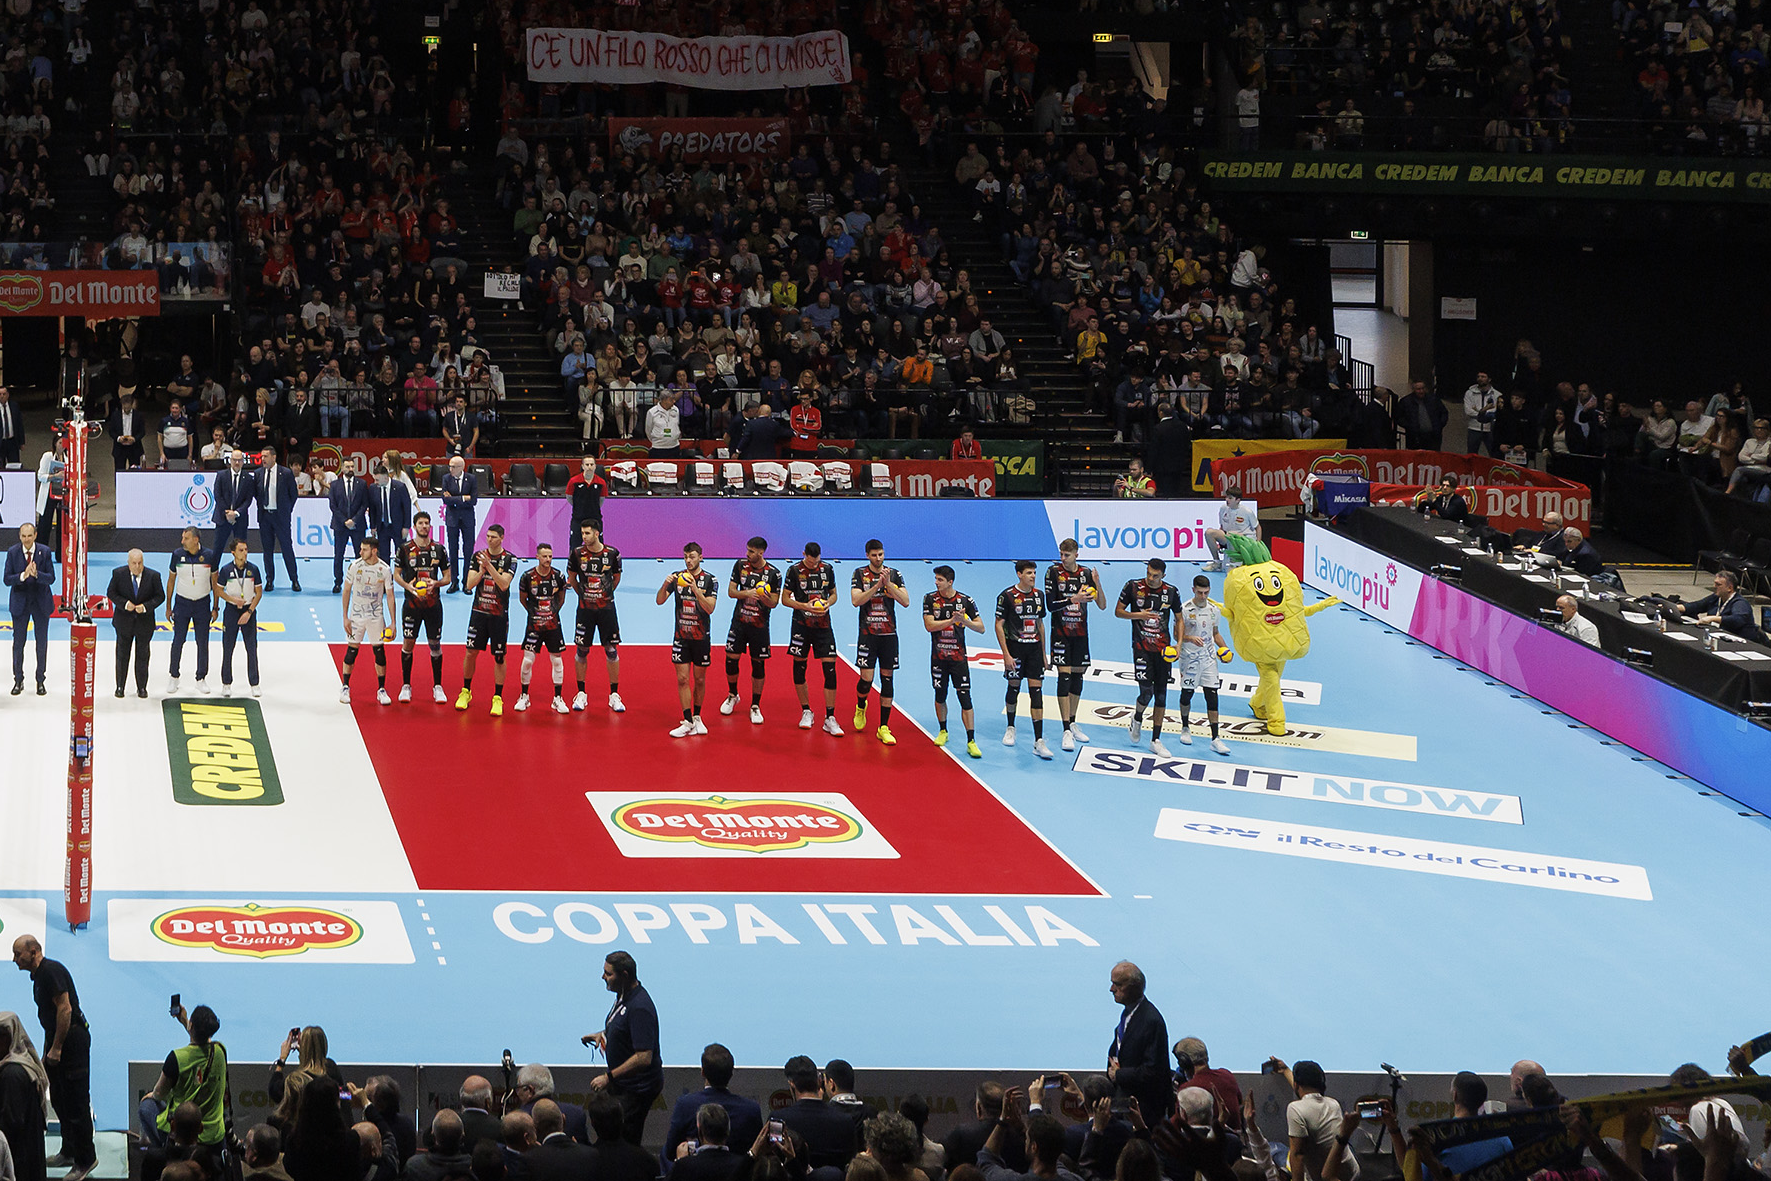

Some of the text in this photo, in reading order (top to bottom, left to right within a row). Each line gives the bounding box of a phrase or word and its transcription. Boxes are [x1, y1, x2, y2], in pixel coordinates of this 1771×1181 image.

[569, 34, 601, 69] UN
[605, 35, 646, 68] FILO
[654, 38, 711, 73] ROSSO
[717, 44, 752, 76] CHE
[755, 44, 771, 74] CI
[1203, 161, 1283, 178] CREDEM
[1291, 162, 1363, 180] BANCA
[1375, 164, 1458, 181] CREDEM
[1468, 165, 1543, 184] BANCA
[1556, 167, 1646, 186] CREDEM
[1655, 169, 1735, 188] BANCA
[0, 285, 39, 296] Del Monte
[49, 281, 157, 305] Del Monte
[907, 473, 992, 497] Monte
[1245, 466, 1305, 493] Monte
[1375, 461, 1408, 485] Del
[1486, 488, 1529, 517] Del
[1074, 519, 1204, 558] lavoropi
[1314, 545, 1390, 611] lavoropiu
[180, 704, 263, 800] CREDEM
[1091, 752, 1504, 816] SKI.IT NOW
[631, 811, 841, 830] Del Monte
[700, 826, 790, 841] Quality
[1277, 833, 1292, 843] il
[1299, 835, 1406, 858] Resto
[1413, 852, 1462, 865] del
[1469, 857, 1620, 885] Carlino
[169, 918, 346, 936] Del Monte
[491, 901, 1101, 947] COPPA ITALIA
[220, 932, 297, 947] Quality
